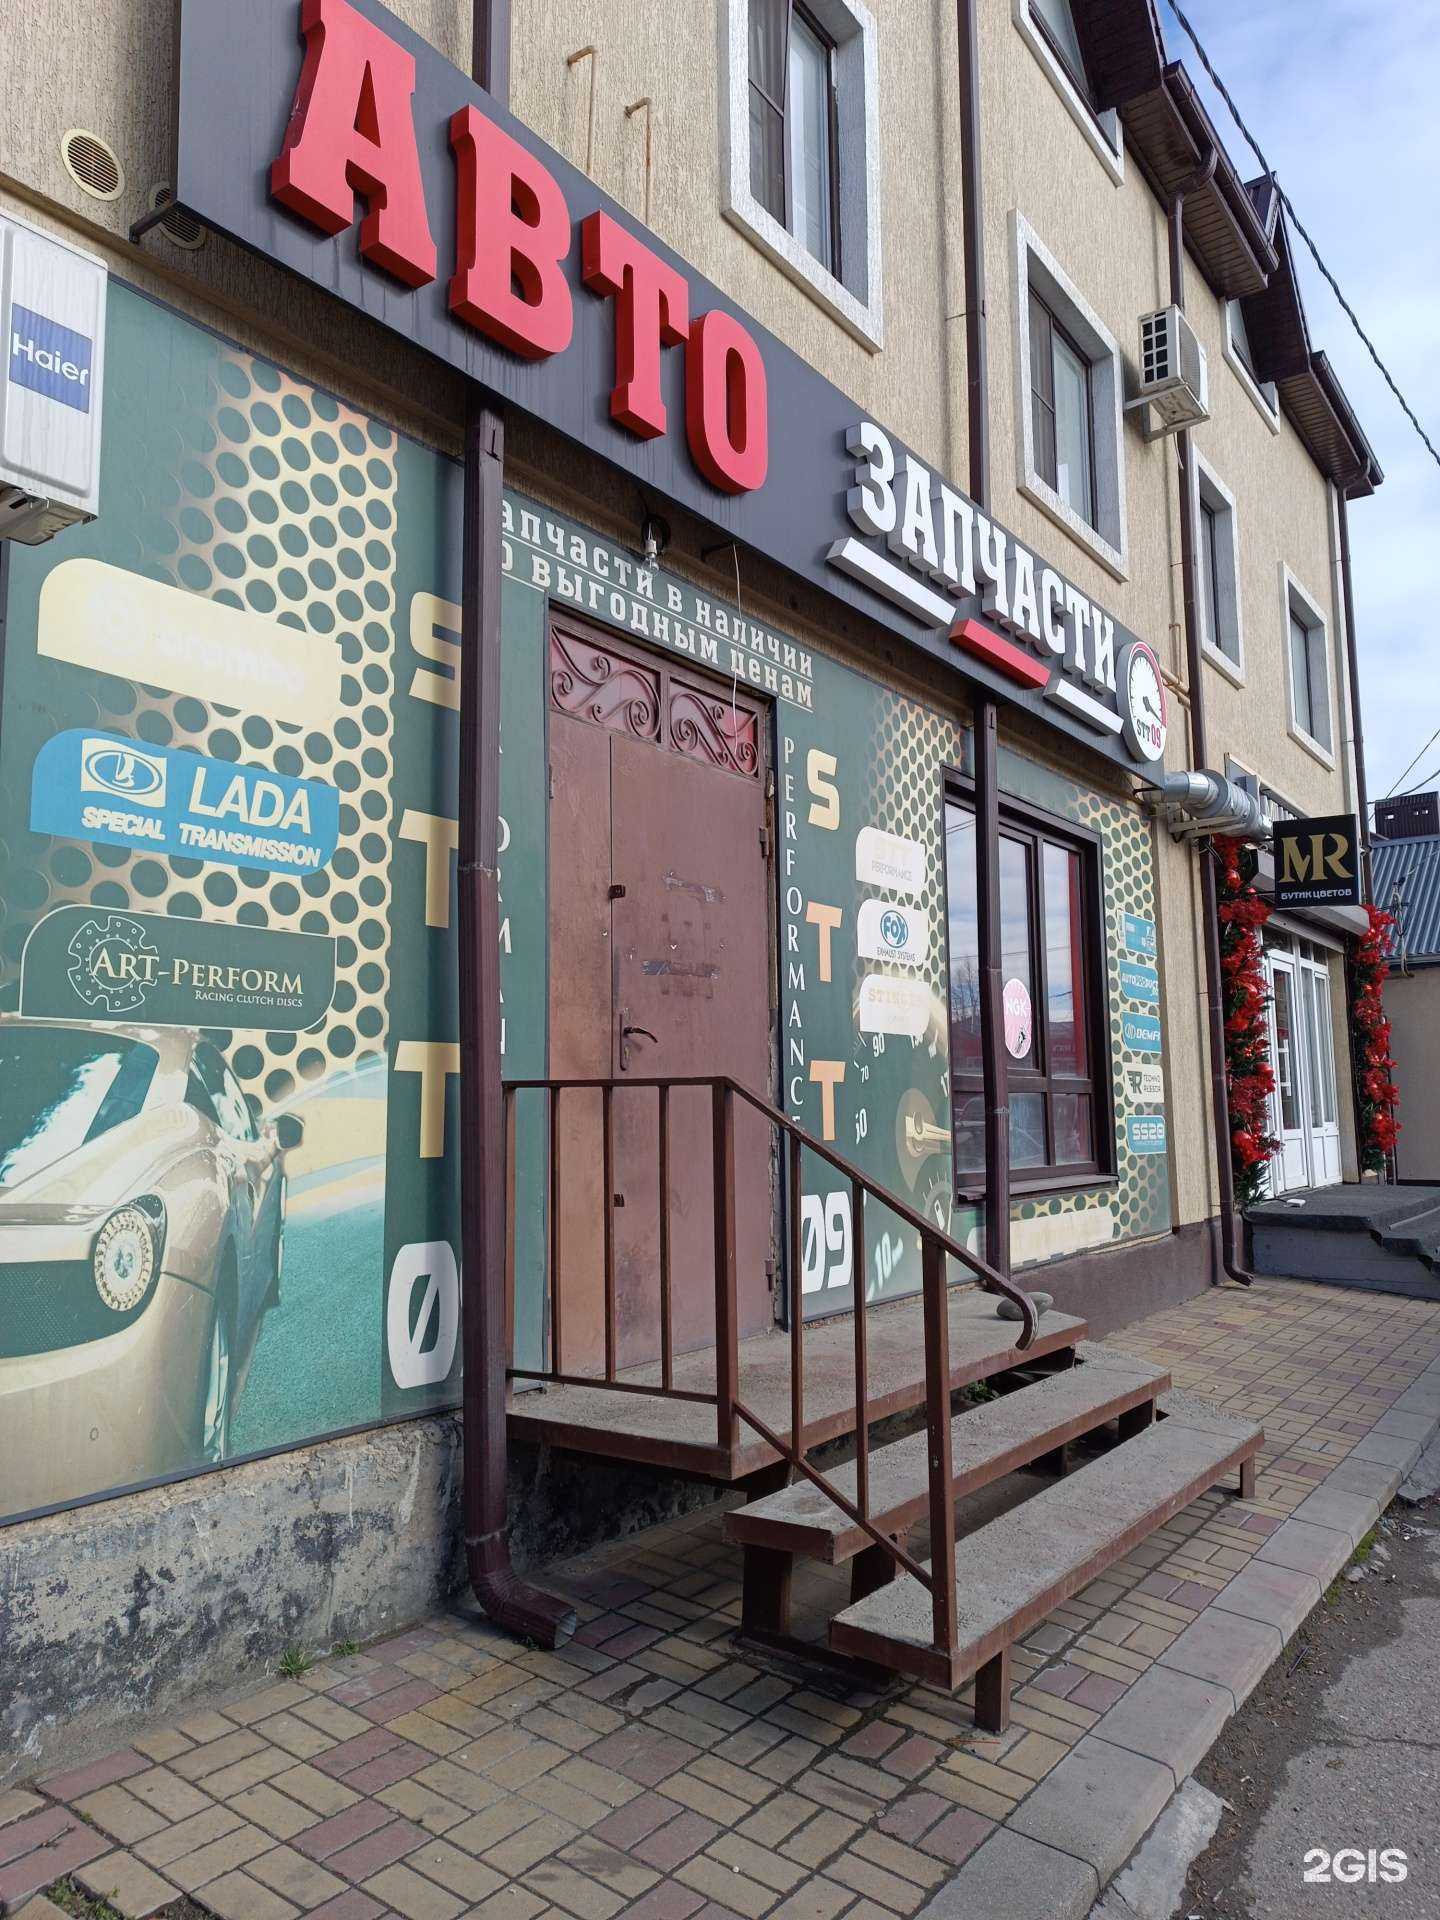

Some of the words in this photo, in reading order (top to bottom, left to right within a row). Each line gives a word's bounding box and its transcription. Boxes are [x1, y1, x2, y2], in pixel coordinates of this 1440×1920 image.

[271, 0, 768, 494] АВТО
[12, 329, 89, 386] Haier
[847, 422, 1117, 697] ЗАПЧАСТИ
[501, 499, 654, 599] апчасти
[667, 584, 683, 612] в
[695, 598, 813, 678] наличии
[531, 554, 719, 665] выгодным
[729, 648, 813, 709] ценам
[188, 766, 312, 834] LADA
[81, 806, 166, 841] SPECIAL
[179, 823, 321, 867] TRANSMISSION
[1279, 833, 1354, 884] MR
[1281, 890, 1313, 900] БУТИК
[1313, 889, 1352, 899] ЦВЕТОВ
[783, 736, 807, 1121] PERFORMANC
[883, 914, 908, 945] FOX
[92, 947, 304, 995] ART-PERFORM
[195, 990, 234, 1003] RACING
[236, 993, 275, 1006] CLUTCH
[276, 996, 303, 1008] DISCS
[1007, 998, 1026, 1018] NGK
[872, 1033, 885, 1057] 90
[860, 1065, 869, 1084] 70
